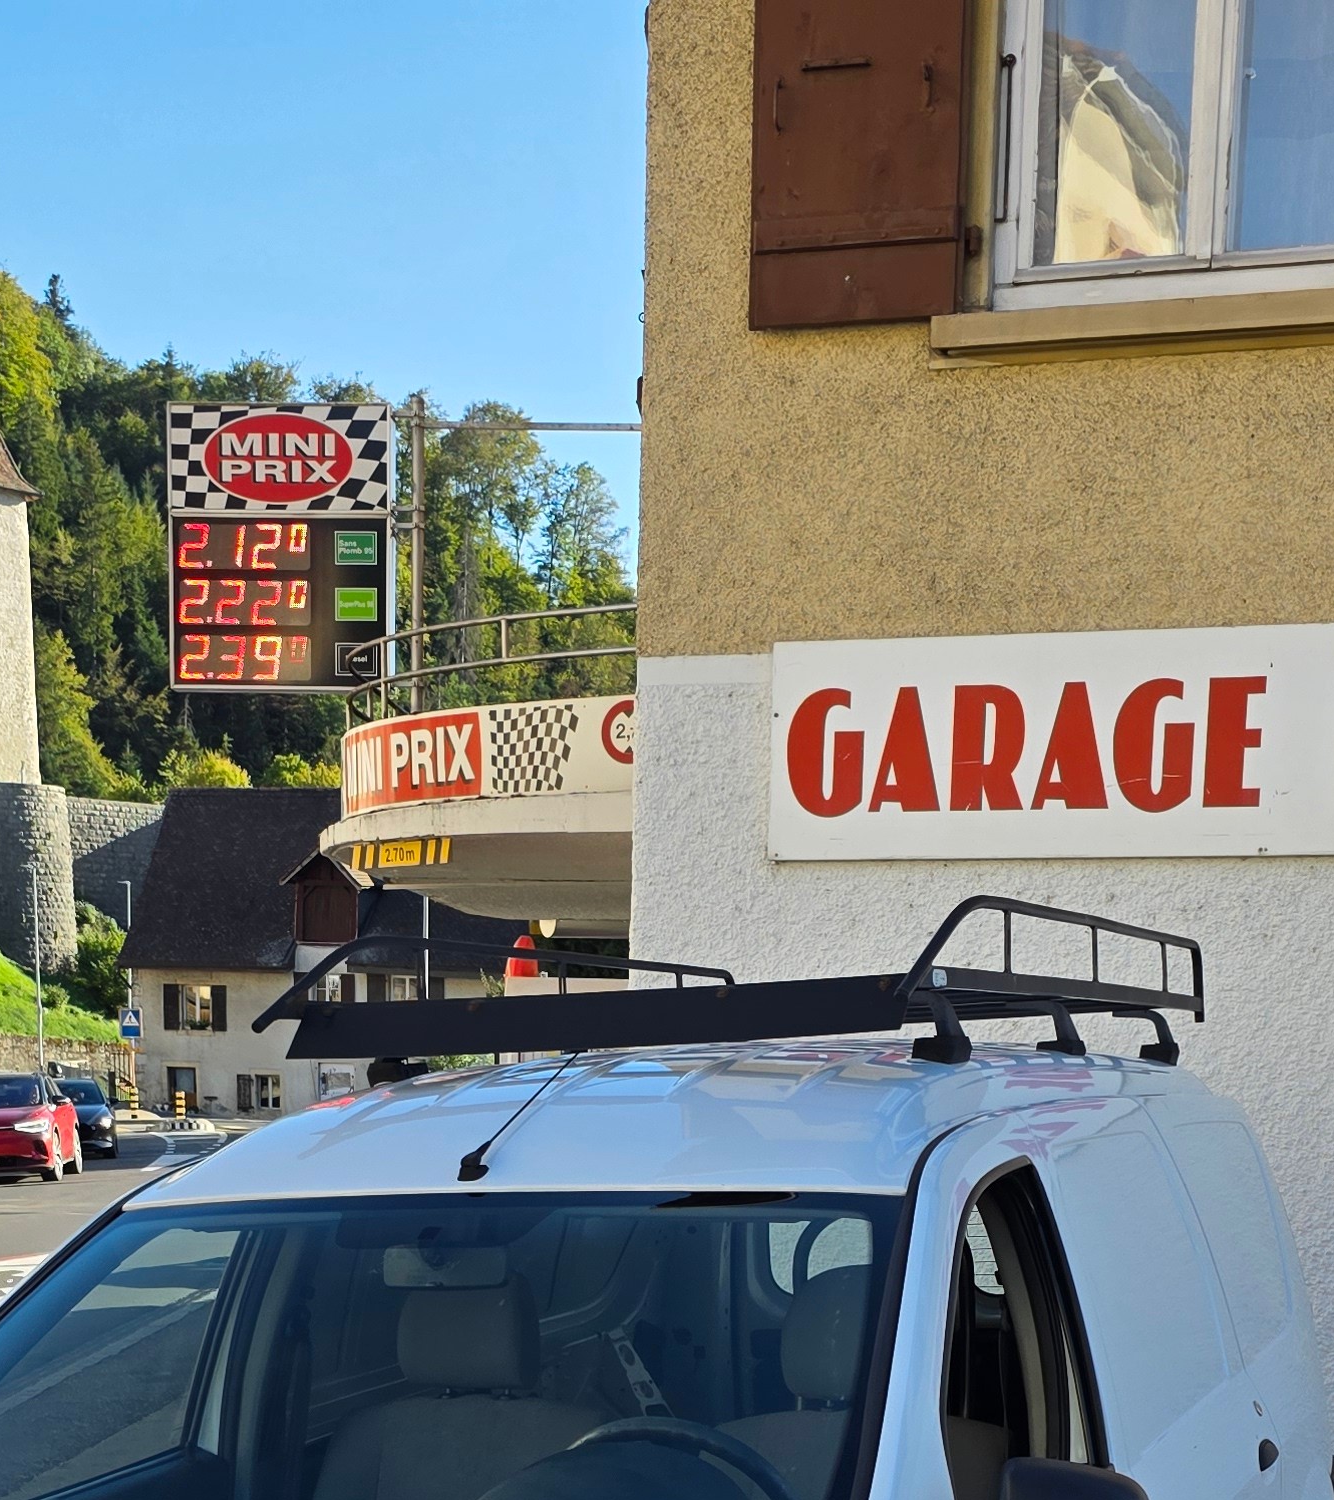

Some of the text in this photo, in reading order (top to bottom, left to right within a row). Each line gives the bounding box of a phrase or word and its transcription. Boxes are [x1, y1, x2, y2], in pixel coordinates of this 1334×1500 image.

[219, 432, 336, 457] MINI
[219, 459, 337, 484] PRIX
[339, 547, 363, 555] Plomb
[786, 677, 1267, 818] GARAGE
[347, 724, 475, 799] MINI PRIX
